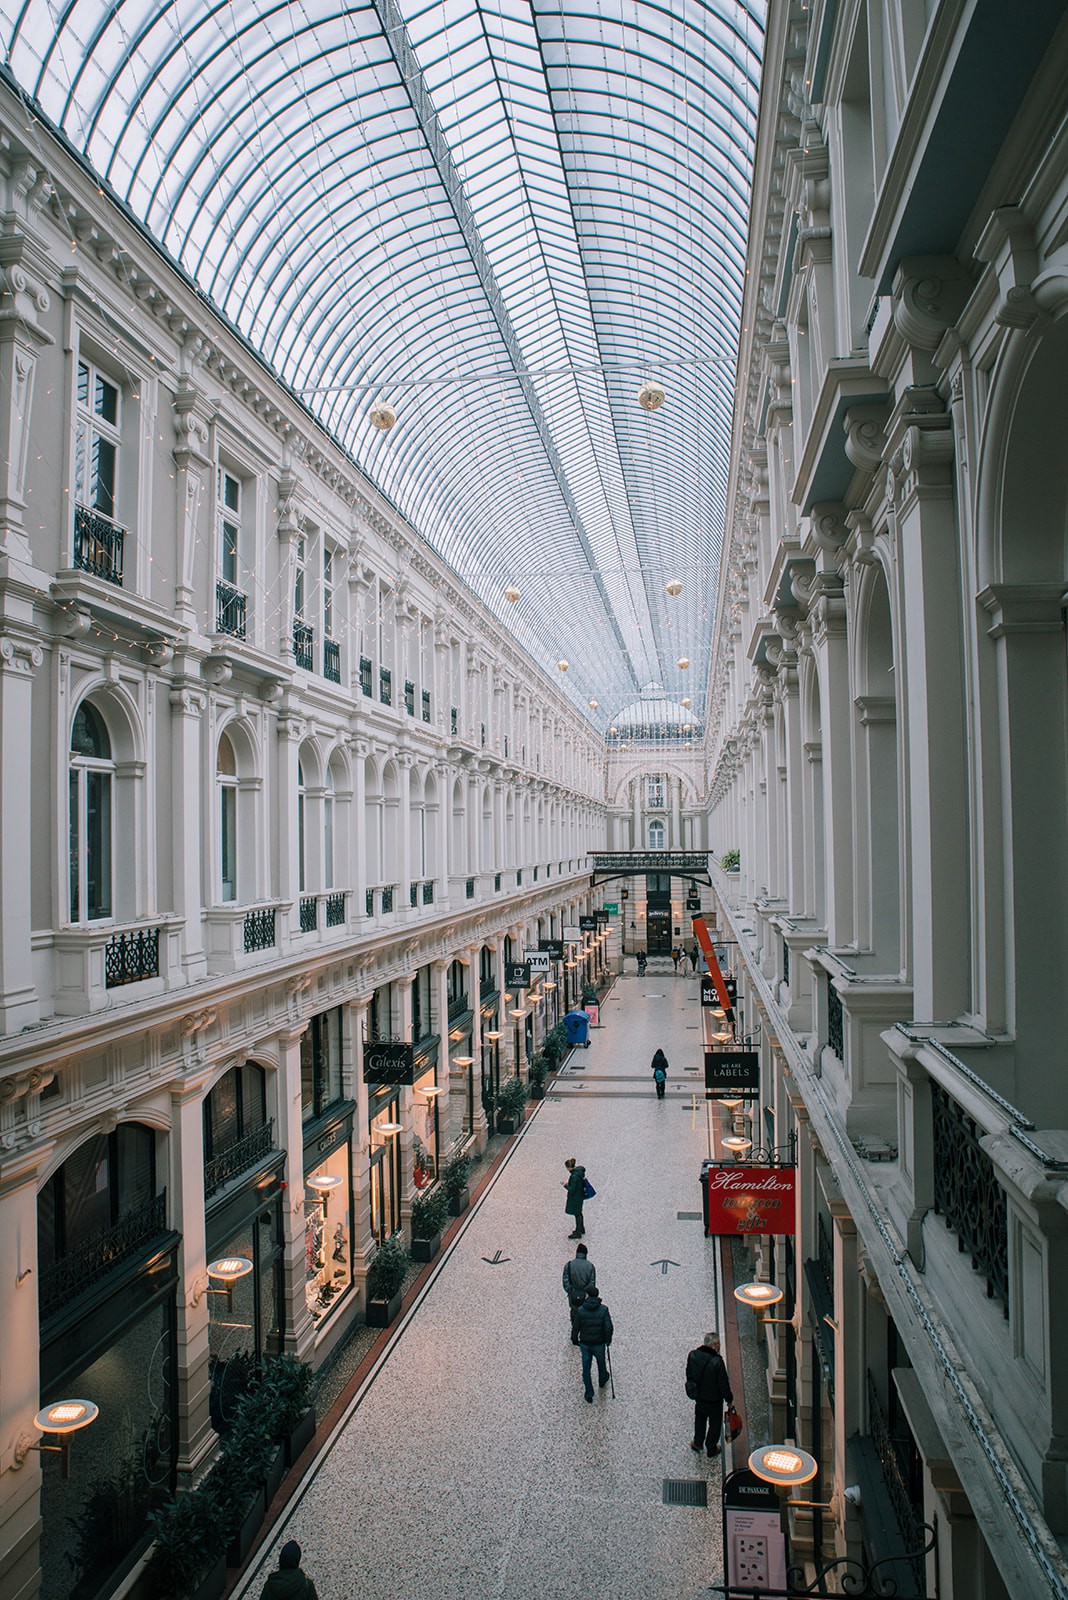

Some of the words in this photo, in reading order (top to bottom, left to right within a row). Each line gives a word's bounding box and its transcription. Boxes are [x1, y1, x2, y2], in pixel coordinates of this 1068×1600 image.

[526, 958, 548, 966] ATM
[369, 1055, 406, 1070] Calexis
[713, 1068, 750, 1077] LABELS
[710, 1171, 793, 1190] Hamilton
[736, 1215, 768, 1231] gifts
